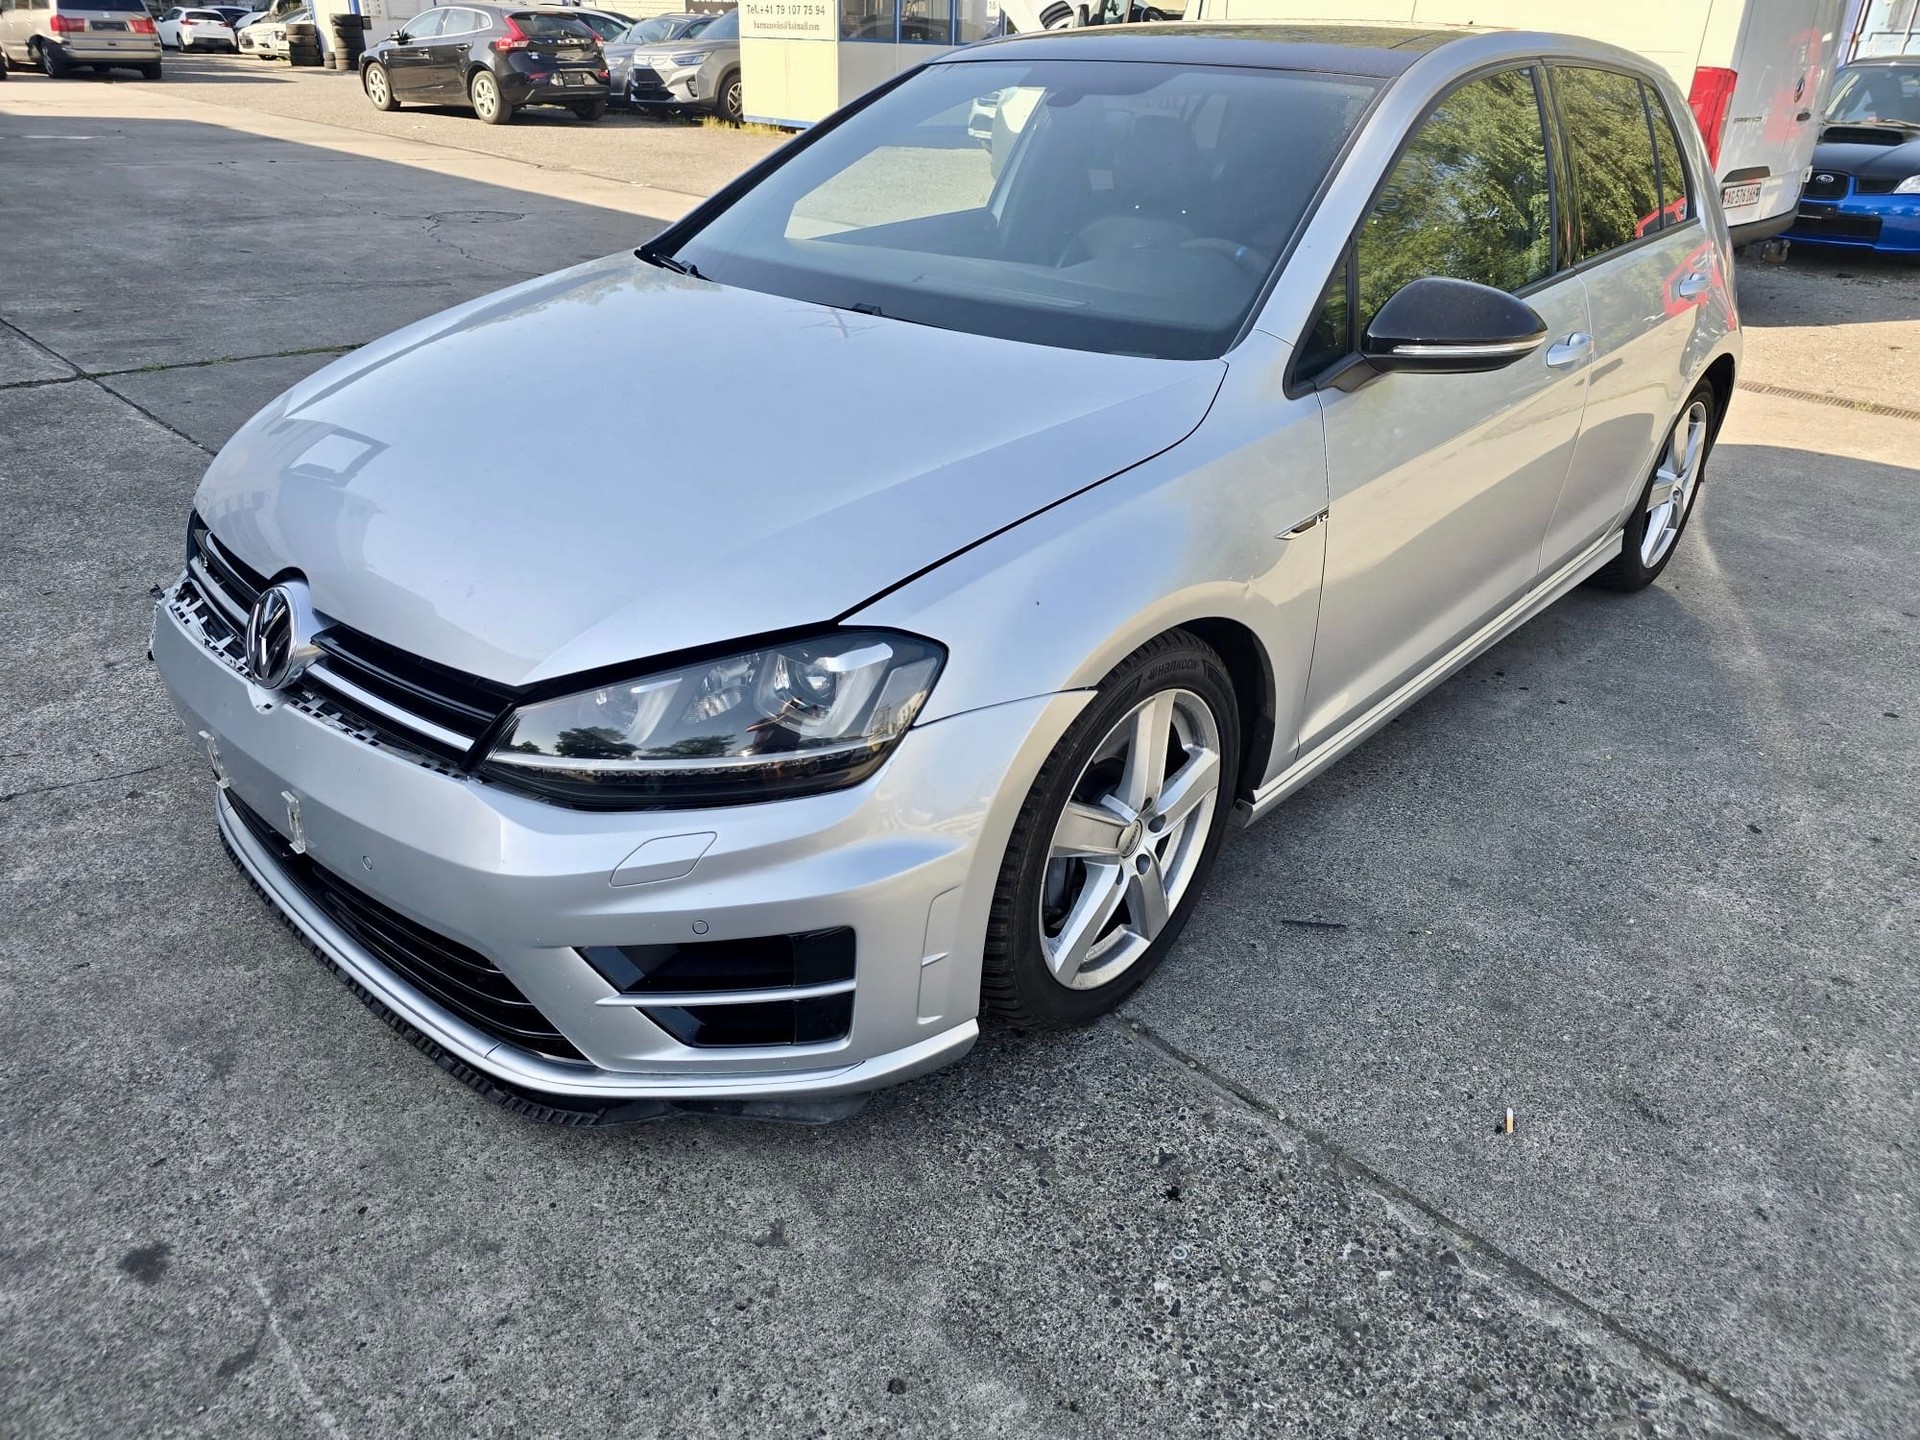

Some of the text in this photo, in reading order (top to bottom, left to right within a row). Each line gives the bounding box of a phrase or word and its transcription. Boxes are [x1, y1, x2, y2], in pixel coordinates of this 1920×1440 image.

[776, 4, 785, 15] 79
[788, 4, 801, 15] 107
[803, 5, 813, 15] 75
[815, 5, 825, 16] 94
